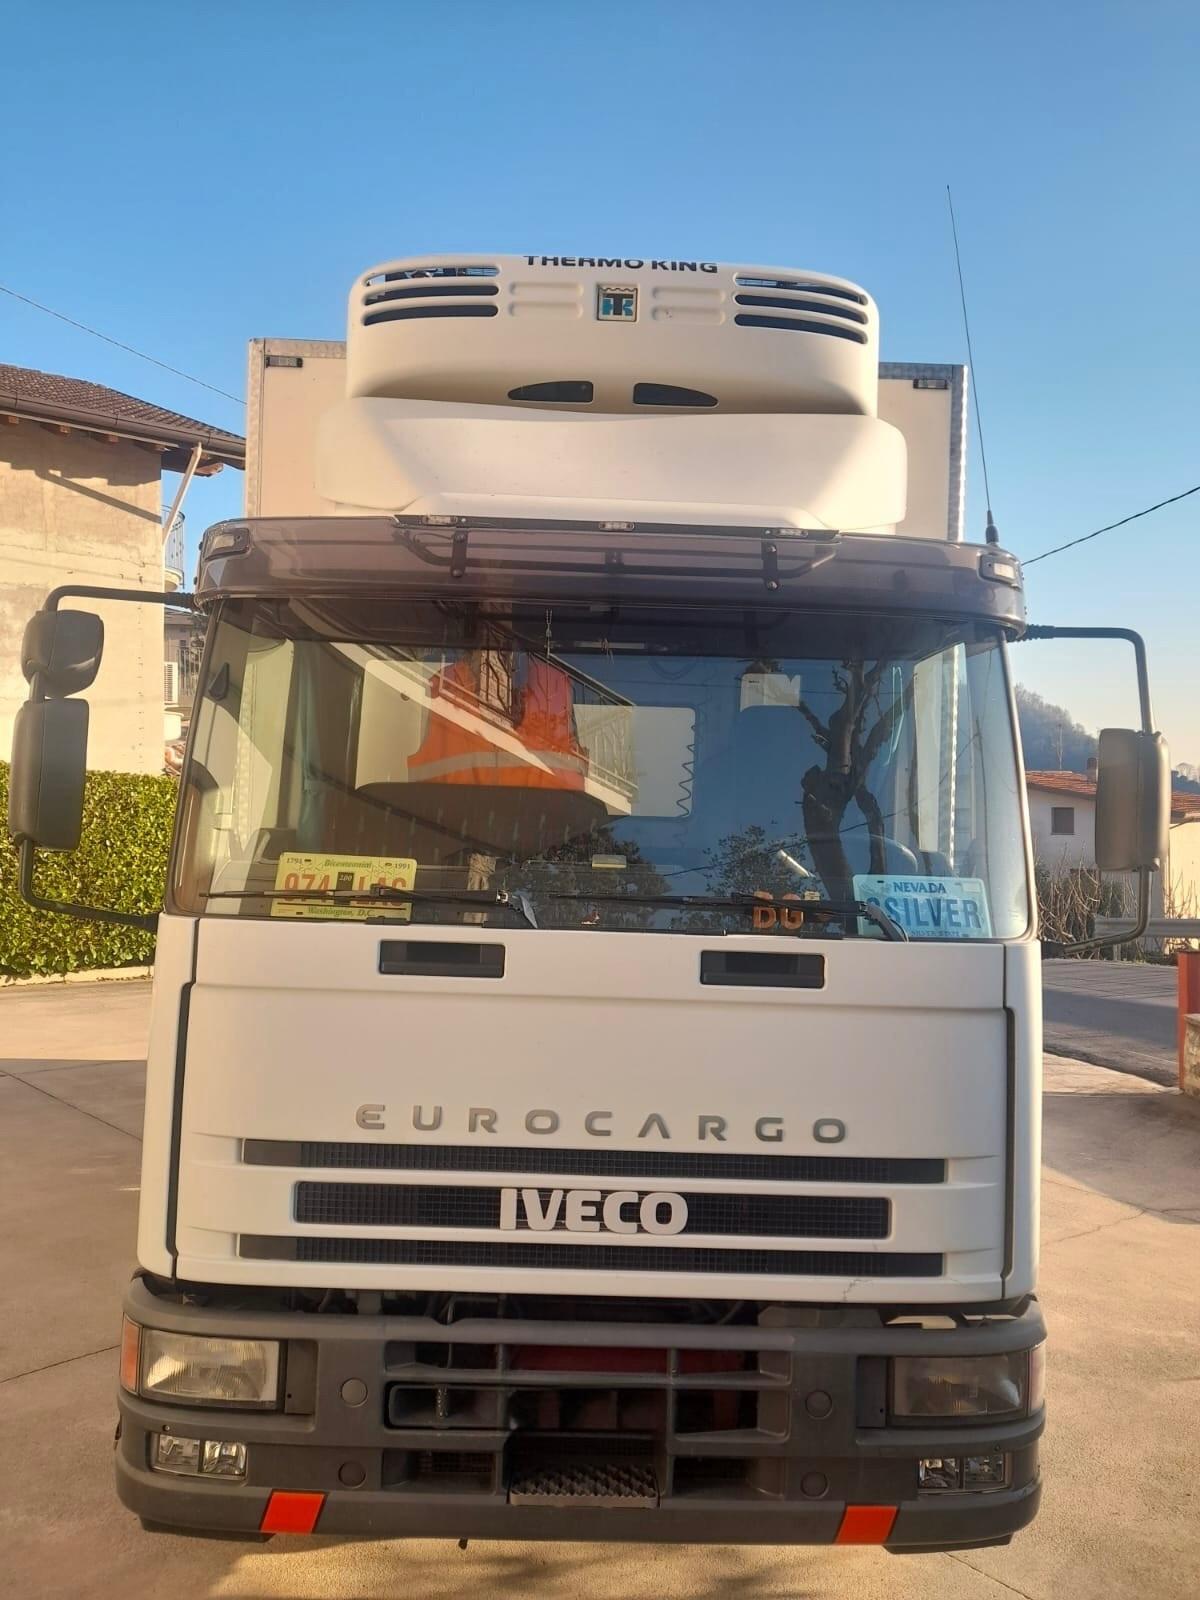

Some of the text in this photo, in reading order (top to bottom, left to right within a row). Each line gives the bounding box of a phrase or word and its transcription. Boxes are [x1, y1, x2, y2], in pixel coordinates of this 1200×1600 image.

[523, 255, 718, 273] THERMO KING
[893, 882, 946, 893] NEVADA
[355, 1103, 846, 1144] EUROCARGO
[500, 1188, 688, 1235] IVECO
